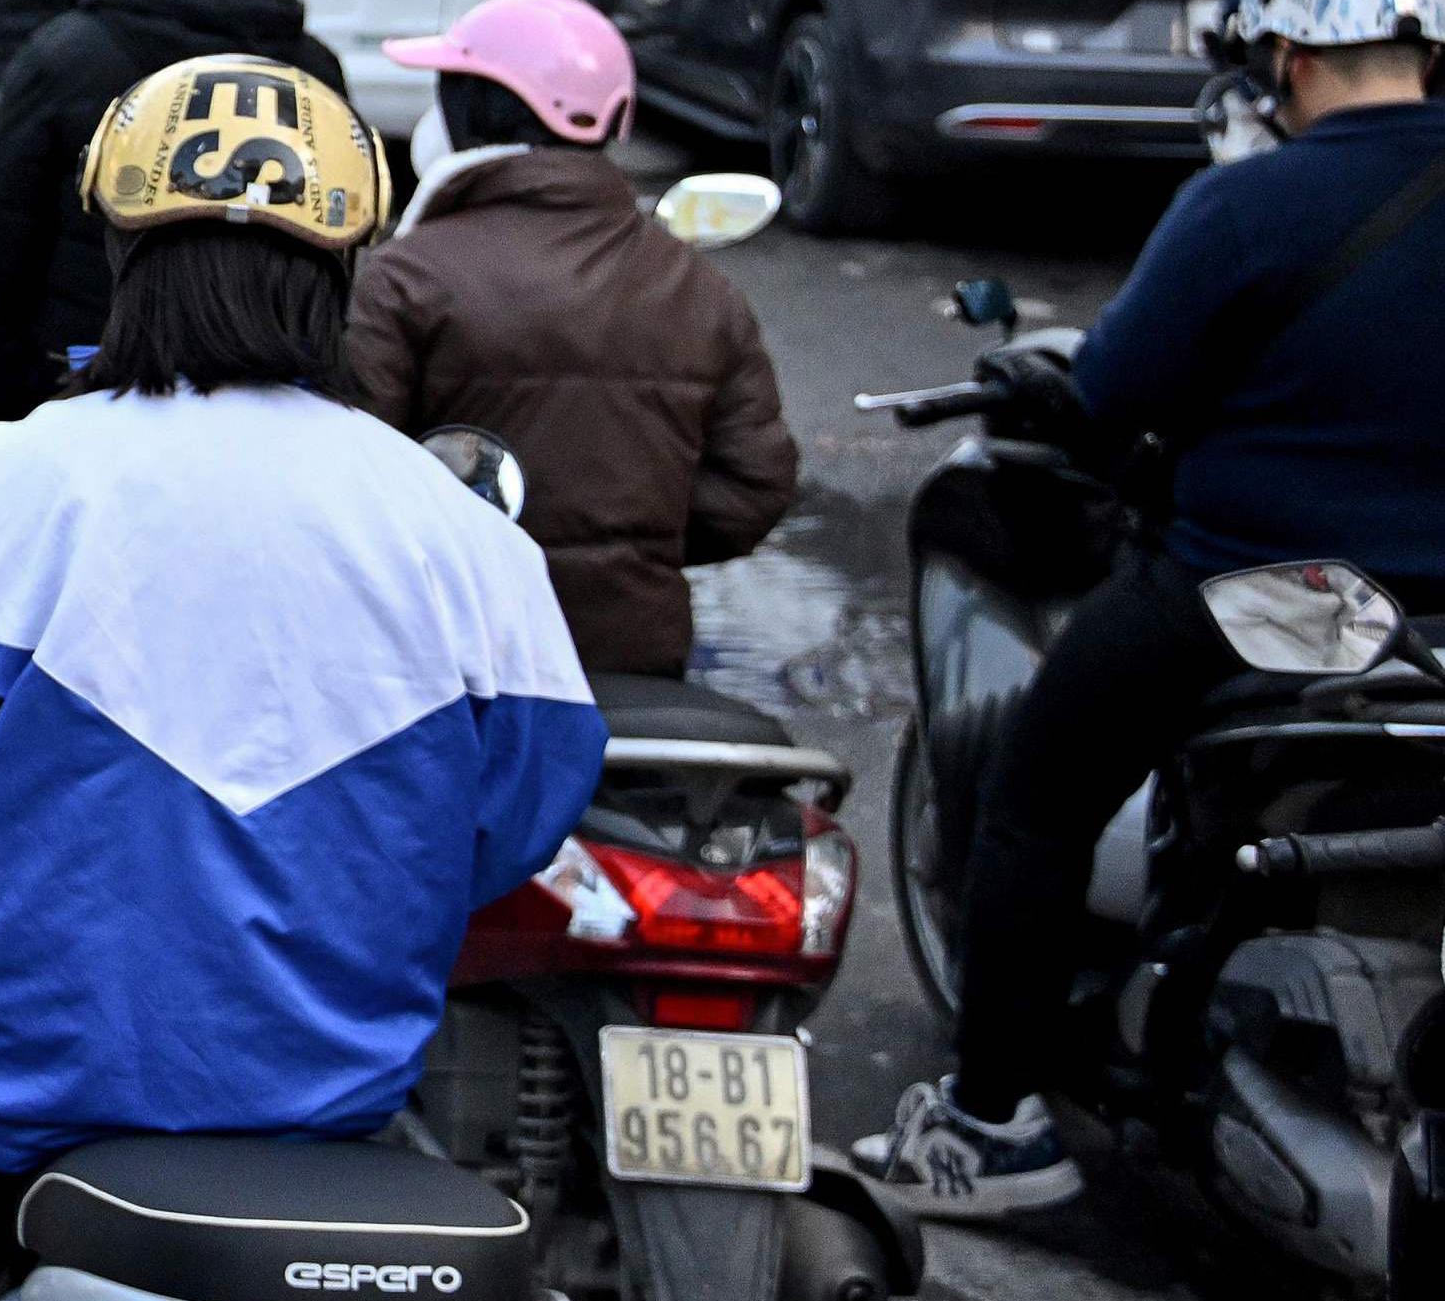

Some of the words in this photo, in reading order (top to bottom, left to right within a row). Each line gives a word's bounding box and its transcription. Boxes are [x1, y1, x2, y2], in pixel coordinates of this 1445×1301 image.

[166, 81, 190, 134] ANDES
[143, 142, 170, 207] ANDES
[638, 1042, 771, 1107] 18-B1
